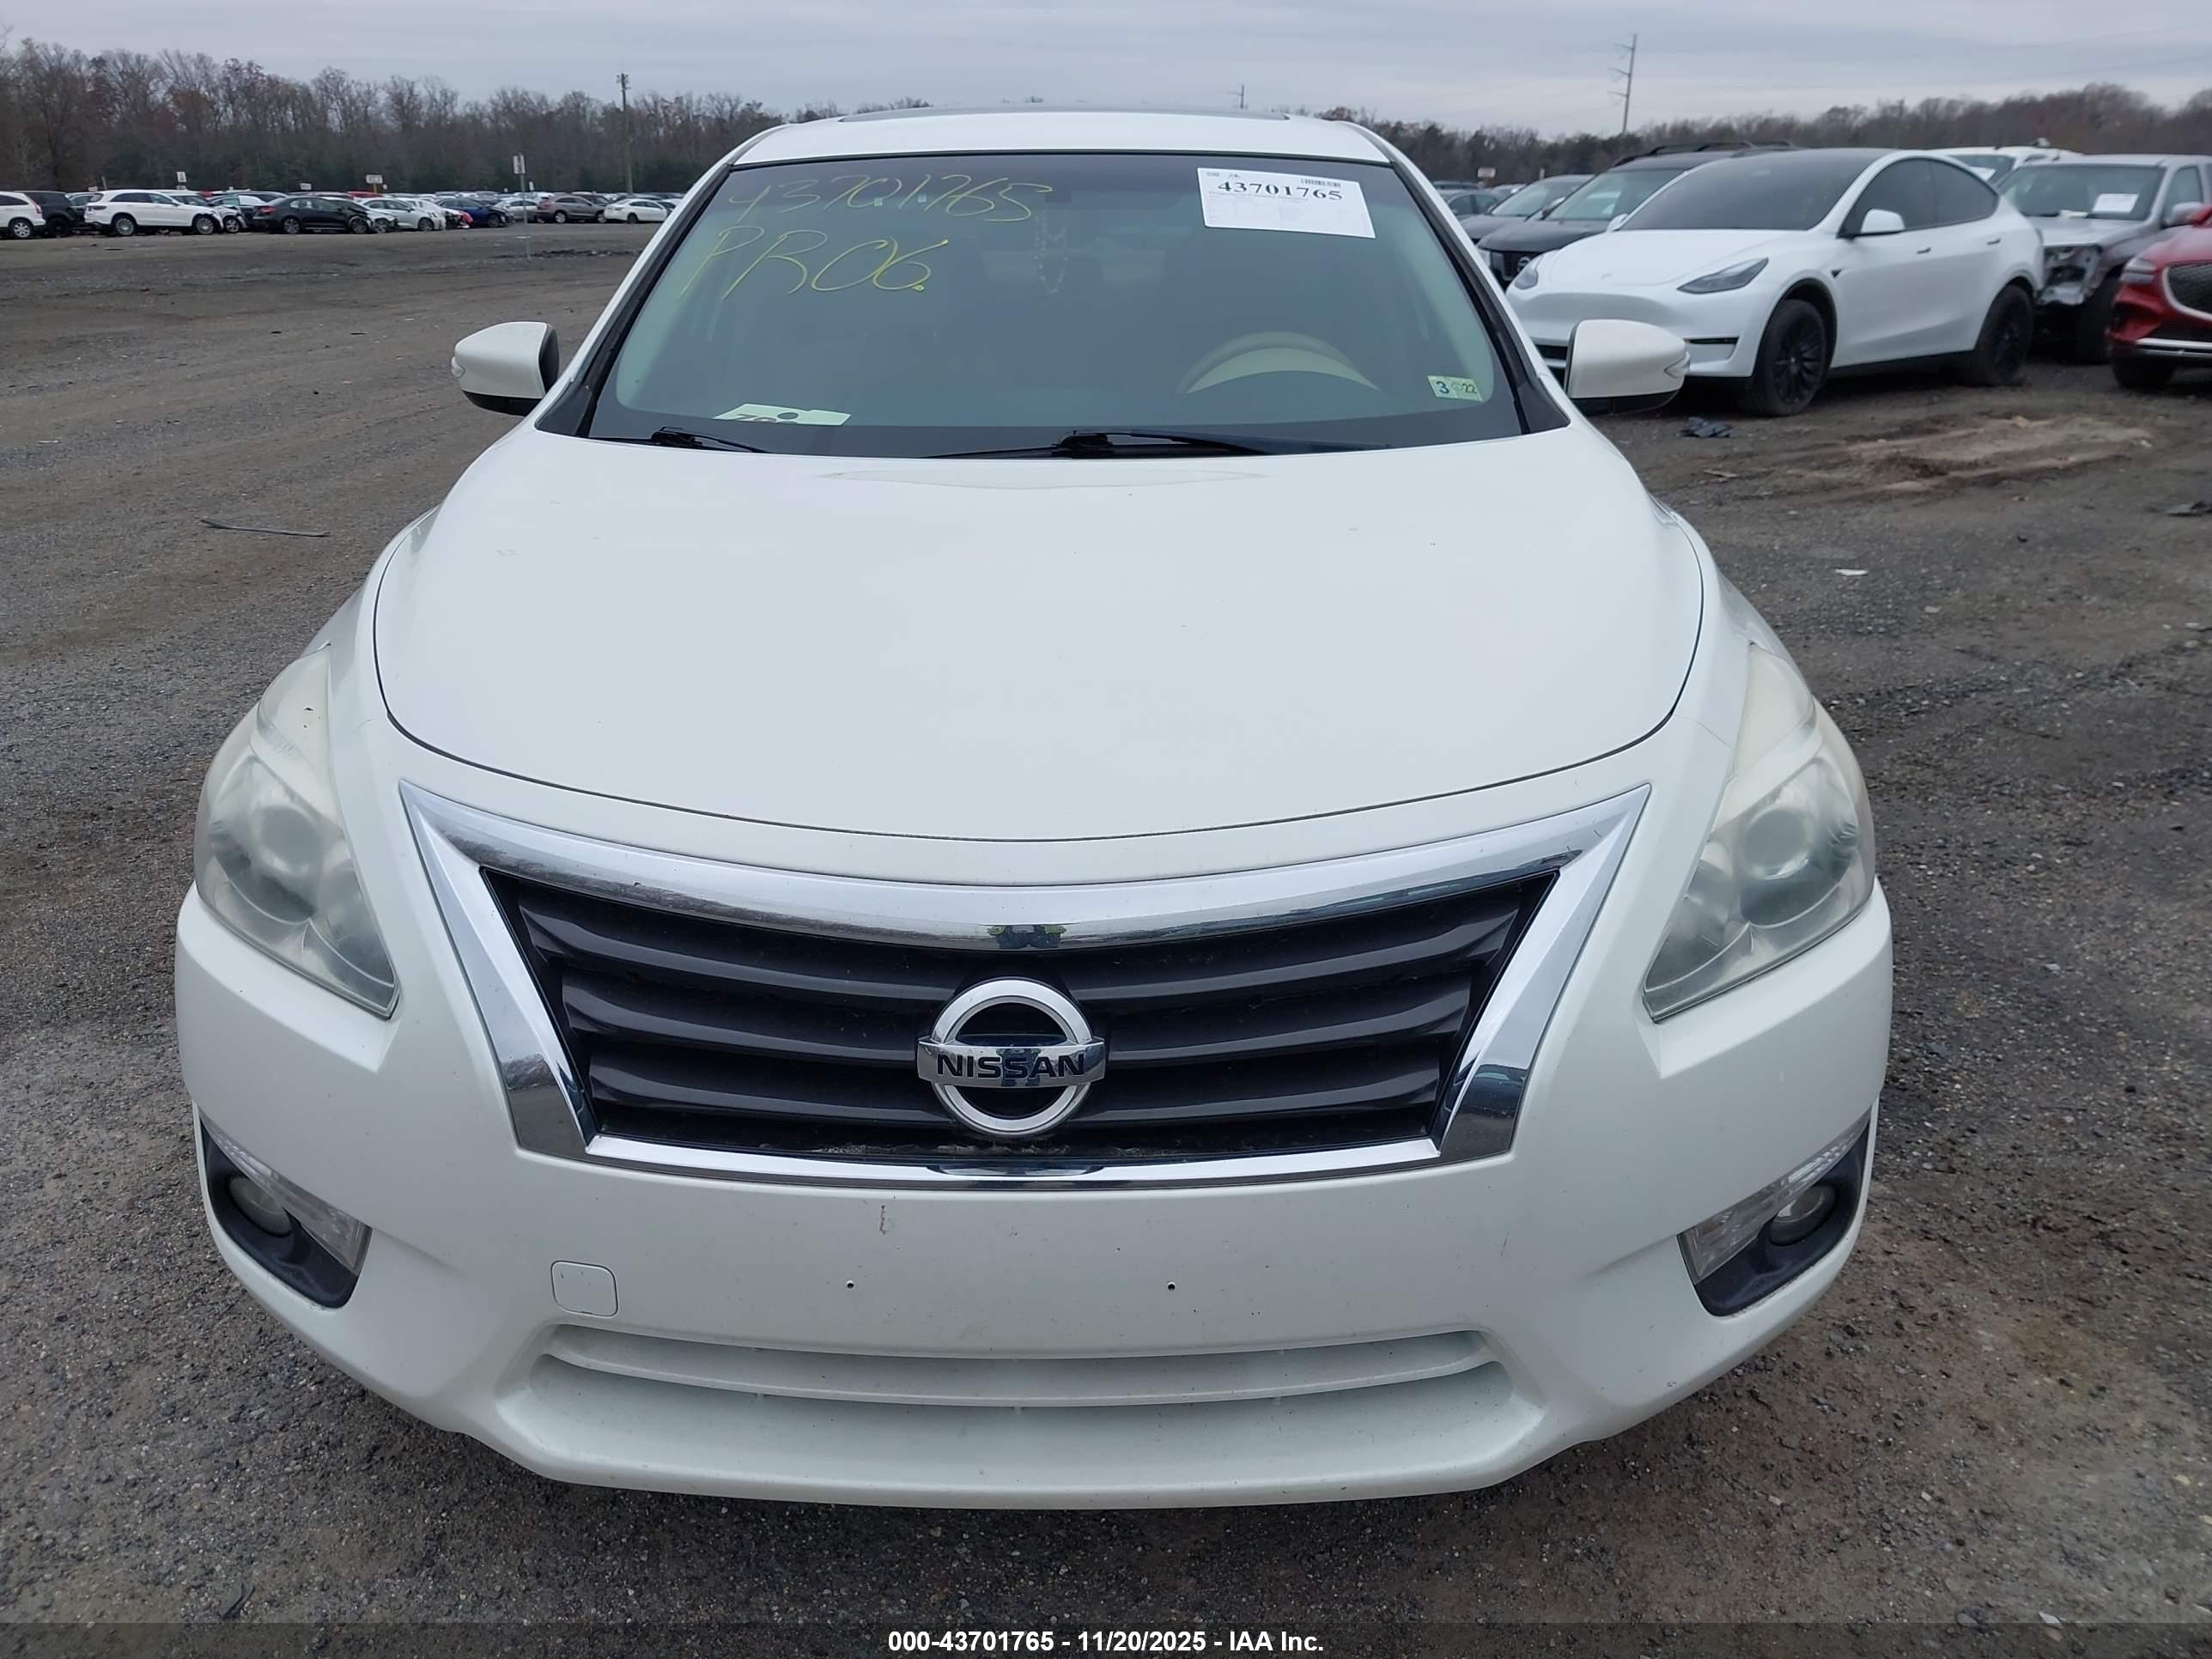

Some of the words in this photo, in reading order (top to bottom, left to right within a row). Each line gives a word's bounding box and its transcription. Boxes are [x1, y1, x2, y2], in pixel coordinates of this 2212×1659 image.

[1217, 181, 1343, 201] 43701765
[1435, 380, 1450, 394] 3
[937, 1054, 1085, 1079] NISSAN
